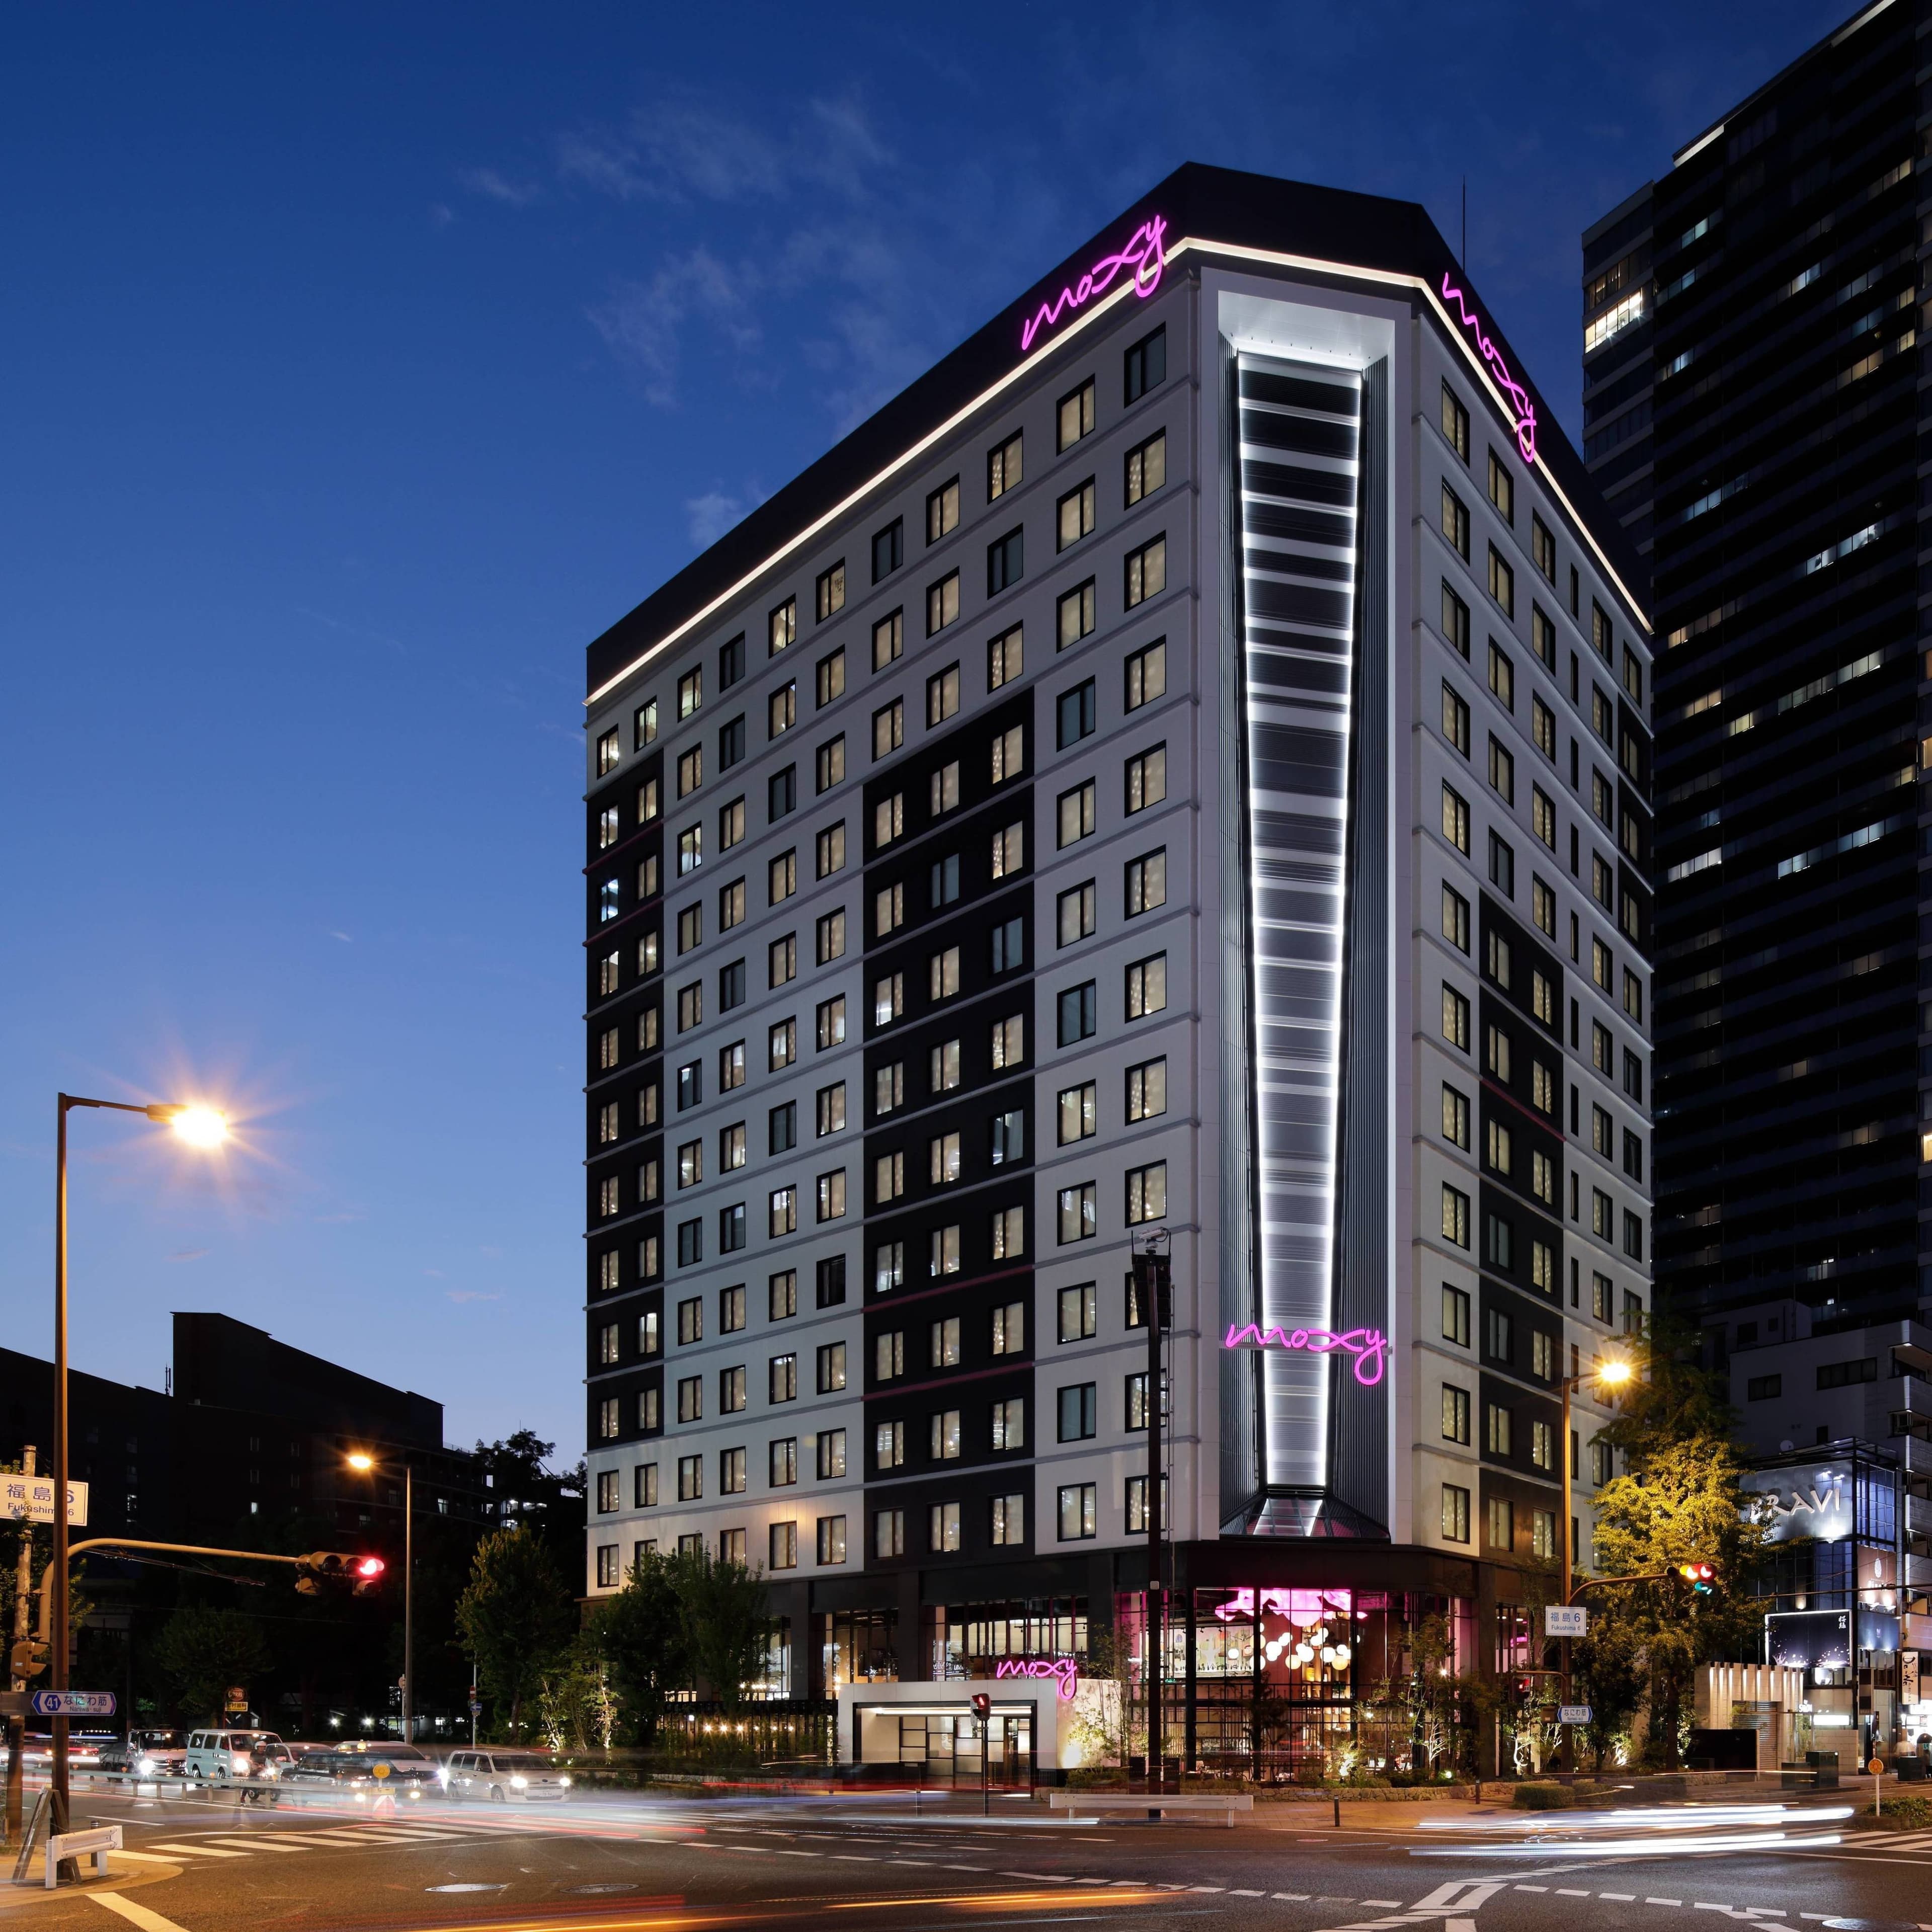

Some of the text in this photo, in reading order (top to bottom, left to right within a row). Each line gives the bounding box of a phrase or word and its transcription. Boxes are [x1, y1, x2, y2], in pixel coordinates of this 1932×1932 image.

[1021, 214, 1167, 351] moxy
[1442, 272, 1537, 463] moxy
[1225, 1323, 1387, 1386] moxy
[8, 1502, 55, 1514] Fukushim
[996, 1659, 1078, 1700] moxy
[47, 1697, 58, 1709] 41
[64, 1695, 107, 1706] なにわ筋
